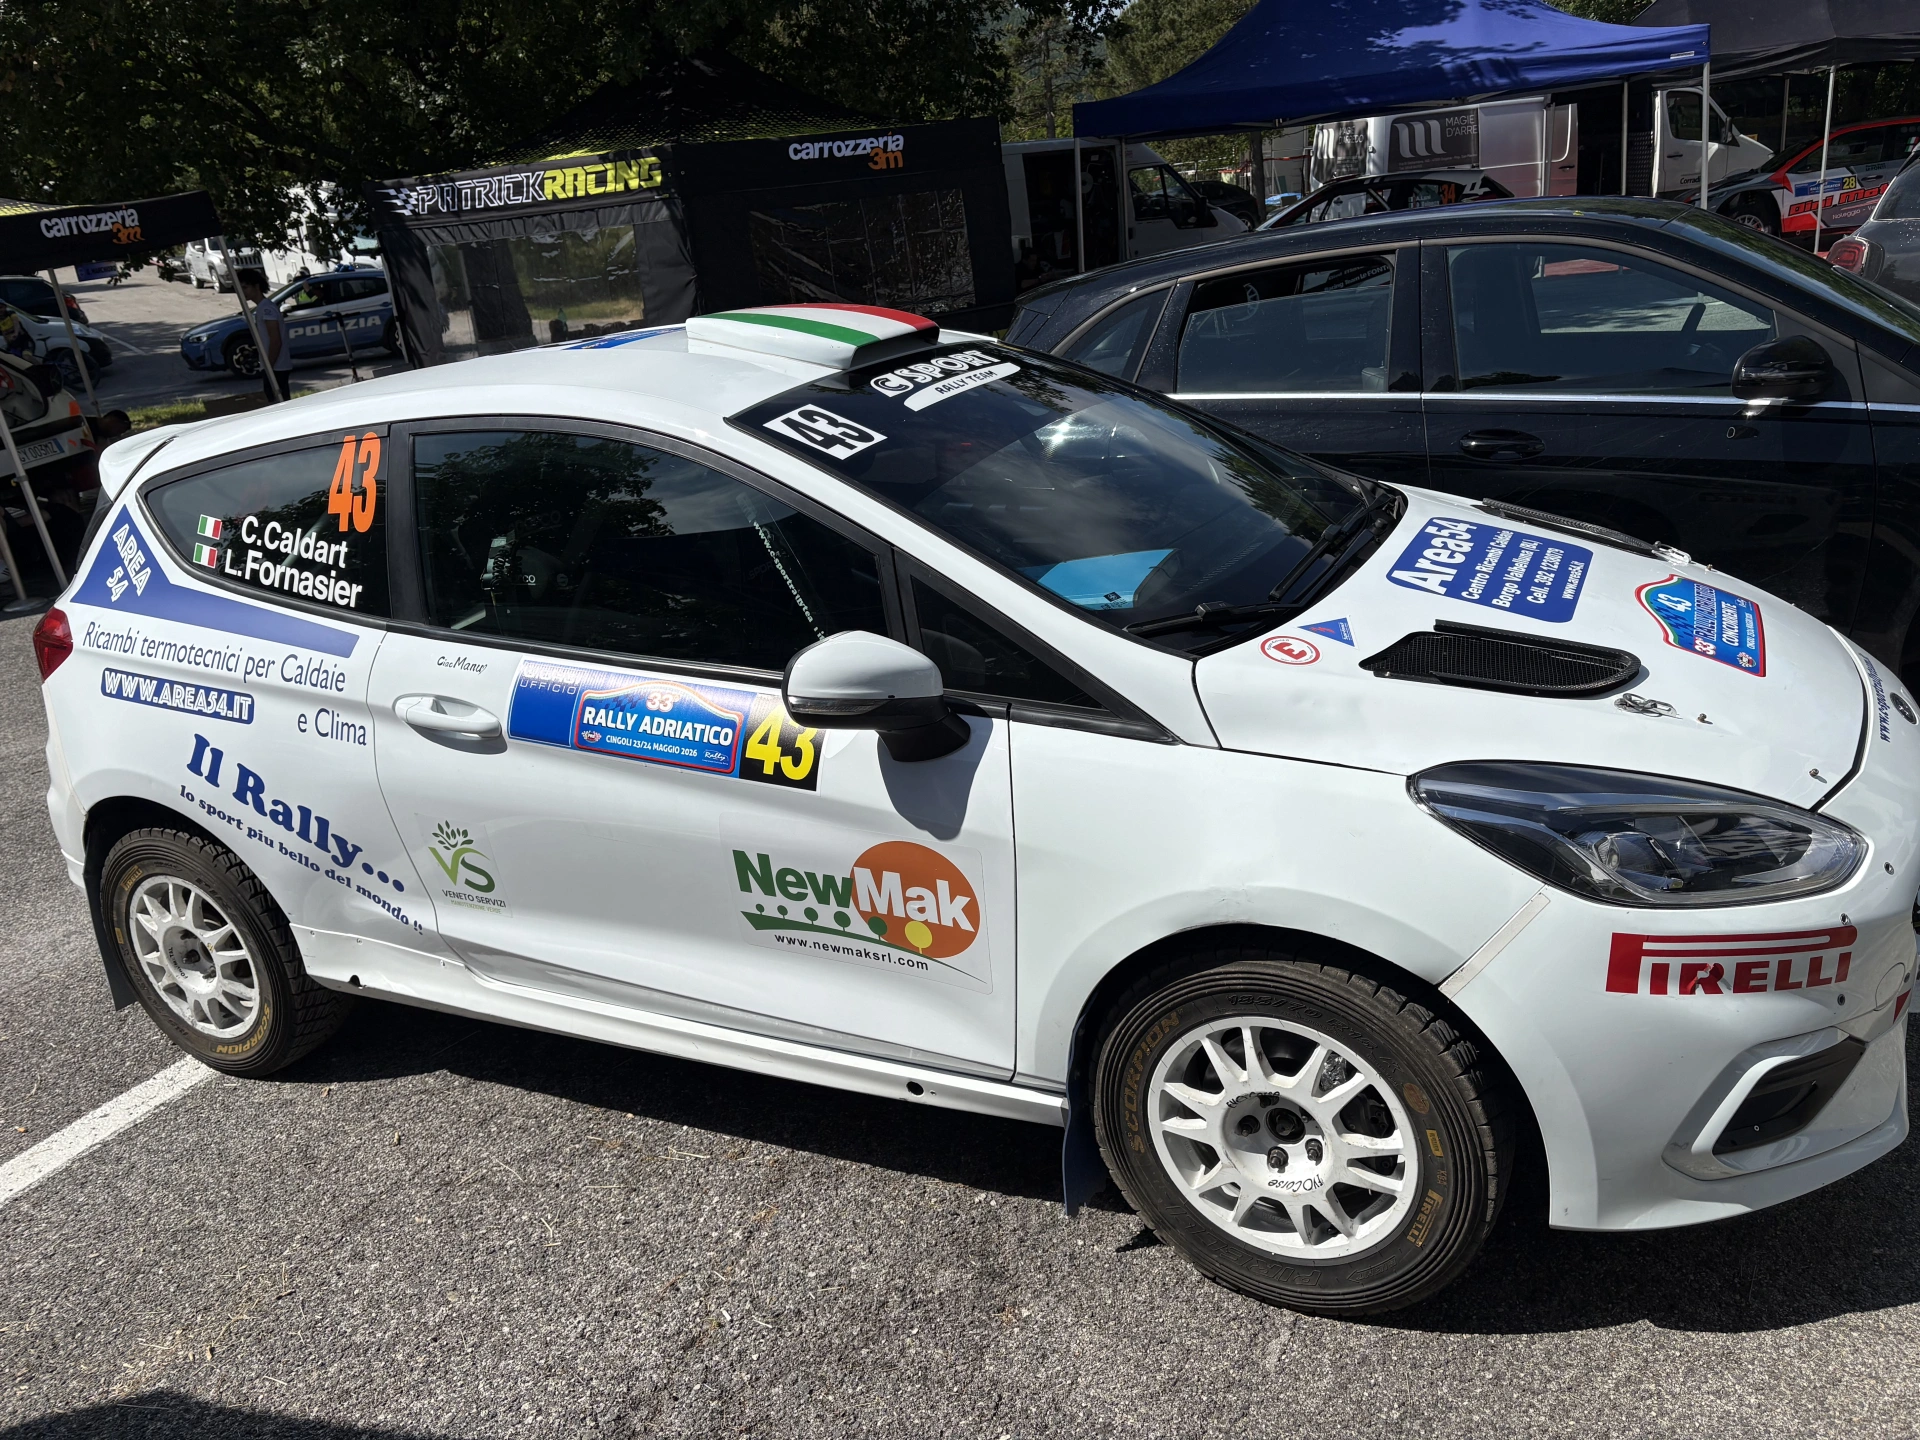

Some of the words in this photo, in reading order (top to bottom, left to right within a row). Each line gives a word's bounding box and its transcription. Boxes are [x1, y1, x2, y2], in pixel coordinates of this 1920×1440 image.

[1445, 115, 1475, 127] MAGIE
[789, 131, 904, 160] carrozzeria
[868, 148, 903, 170] 3m
[1441, 183, 1456, 205] 34
[1843, 177, 1856, 190] 28
[40, 204, 139, 239] carrozzeria
[1832, 208, 1861, 219] Noleggio
[112, 223, 145, 244] 3m
[934, 378, 968, 395] RALLY
[967, 369, 998, 385] TEAM
[780, 409, 875, 450] 43
[328, 432, 382, 533] 43
[112, 523, 152, 597] AREA
[241, 515, 348, 569] C.Caldart
[1391, 519, 1477, 595] Area54
[106, 566, 129, 602] 54
[224, 548, 363, 608] L.Fornasier
[1461, 571, 1489, 600] Centro
[1475, 545, 1504, 573] Ricambi
[1534, 570, 1555, 585] 392
[1492, 580, 1521, 608] Borgo
[1527, 584, 1549, 604] Cell.
[1657, 593, 1692, 612] 43
[82, 621, 140, 657] Ricambi
[140, 637, 243, 673] termotecnici
[244, 656, 276, 683] per
[280, 654, 346, 693] Caldaie
[453, 656, 485, 674] Manu
[104, 669, 252, 721] WWW.AREA54.IT
[520, 679, 576, 695] UFFICIO
[297, 713, 307, 733] e
[314, 707, 367, 746] Clima
[583, 706, 638, 731] RALLY
[638, 715, 733, 747] ADRIATICO
[606, 735, 632, 747] CINGOLI
[633, 739, 651, 751] 23/24
[652, 743, 680, 755] MAGGIO
[681, 747, 698, 757] 2026
[745, 704, 818, 781] 43
[186, 733, 224, 788] Il
[179, 785, 195, 802] lo
[199, 798, 244, 831] sport
[247, 824, 274, 849] piu
[278, 838, 321, 872] bello
[324, 866, 352, 889] del
[355, 883, 409, 925] mondo
[428, 847, 496, 893] VS
[442, 889, 475, 902] VENETO
[475, 895, 507, 908] SERVIZI
[732, 849, 975, 932] NewMak
[774, 932, 929, 971] www.newmaksrl.com
[1605, 925, 1858, 995] PIRELLI
[216, 1004, 270, 1054] SCORPION
[1124, 1012, 1180, 1154] SCORPION
[1407, 1189, 1443, 1248] PIRELLI
